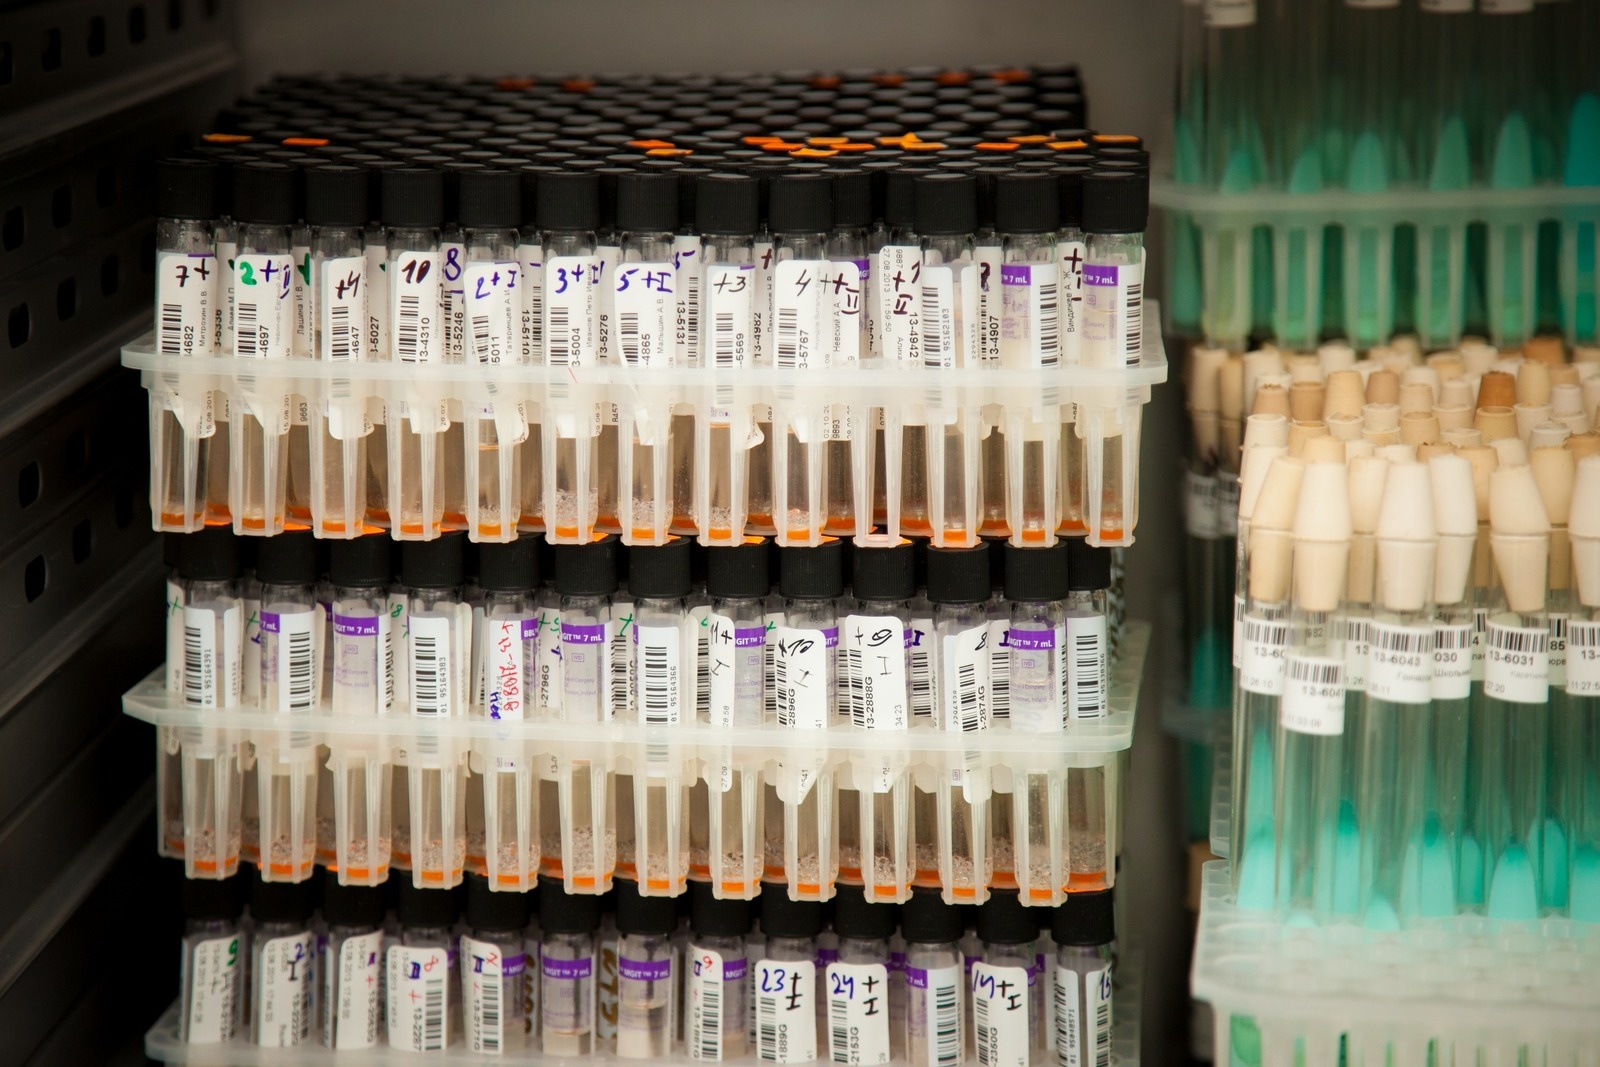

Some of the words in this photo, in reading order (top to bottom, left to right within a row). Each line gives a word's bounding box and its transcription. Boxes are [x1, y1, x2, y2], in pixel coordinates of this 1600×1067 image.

[184, 326, 194, 356] 4682
[260, 326, 268, 359] -4697
[420, 317, 430, 363] 13-4310
[455, 312, 463, 355] 13-5246
[736, 333, 744, 367] -5569
[909, 312, 918, 358] 13-4942
[990, 315, 999, 360] 13-4907
[491, 336, 500, 366] 5011
[642, 334, 650, 368] -4865
[1306, 628, 1323, 637] 982
[1435, 652, 1457, 662] 030
[1489, 650, 1534, 665] 13-6031
[541, 665, 550, 707] -2796G
[865, 676, 875, 730] 13-2888G
